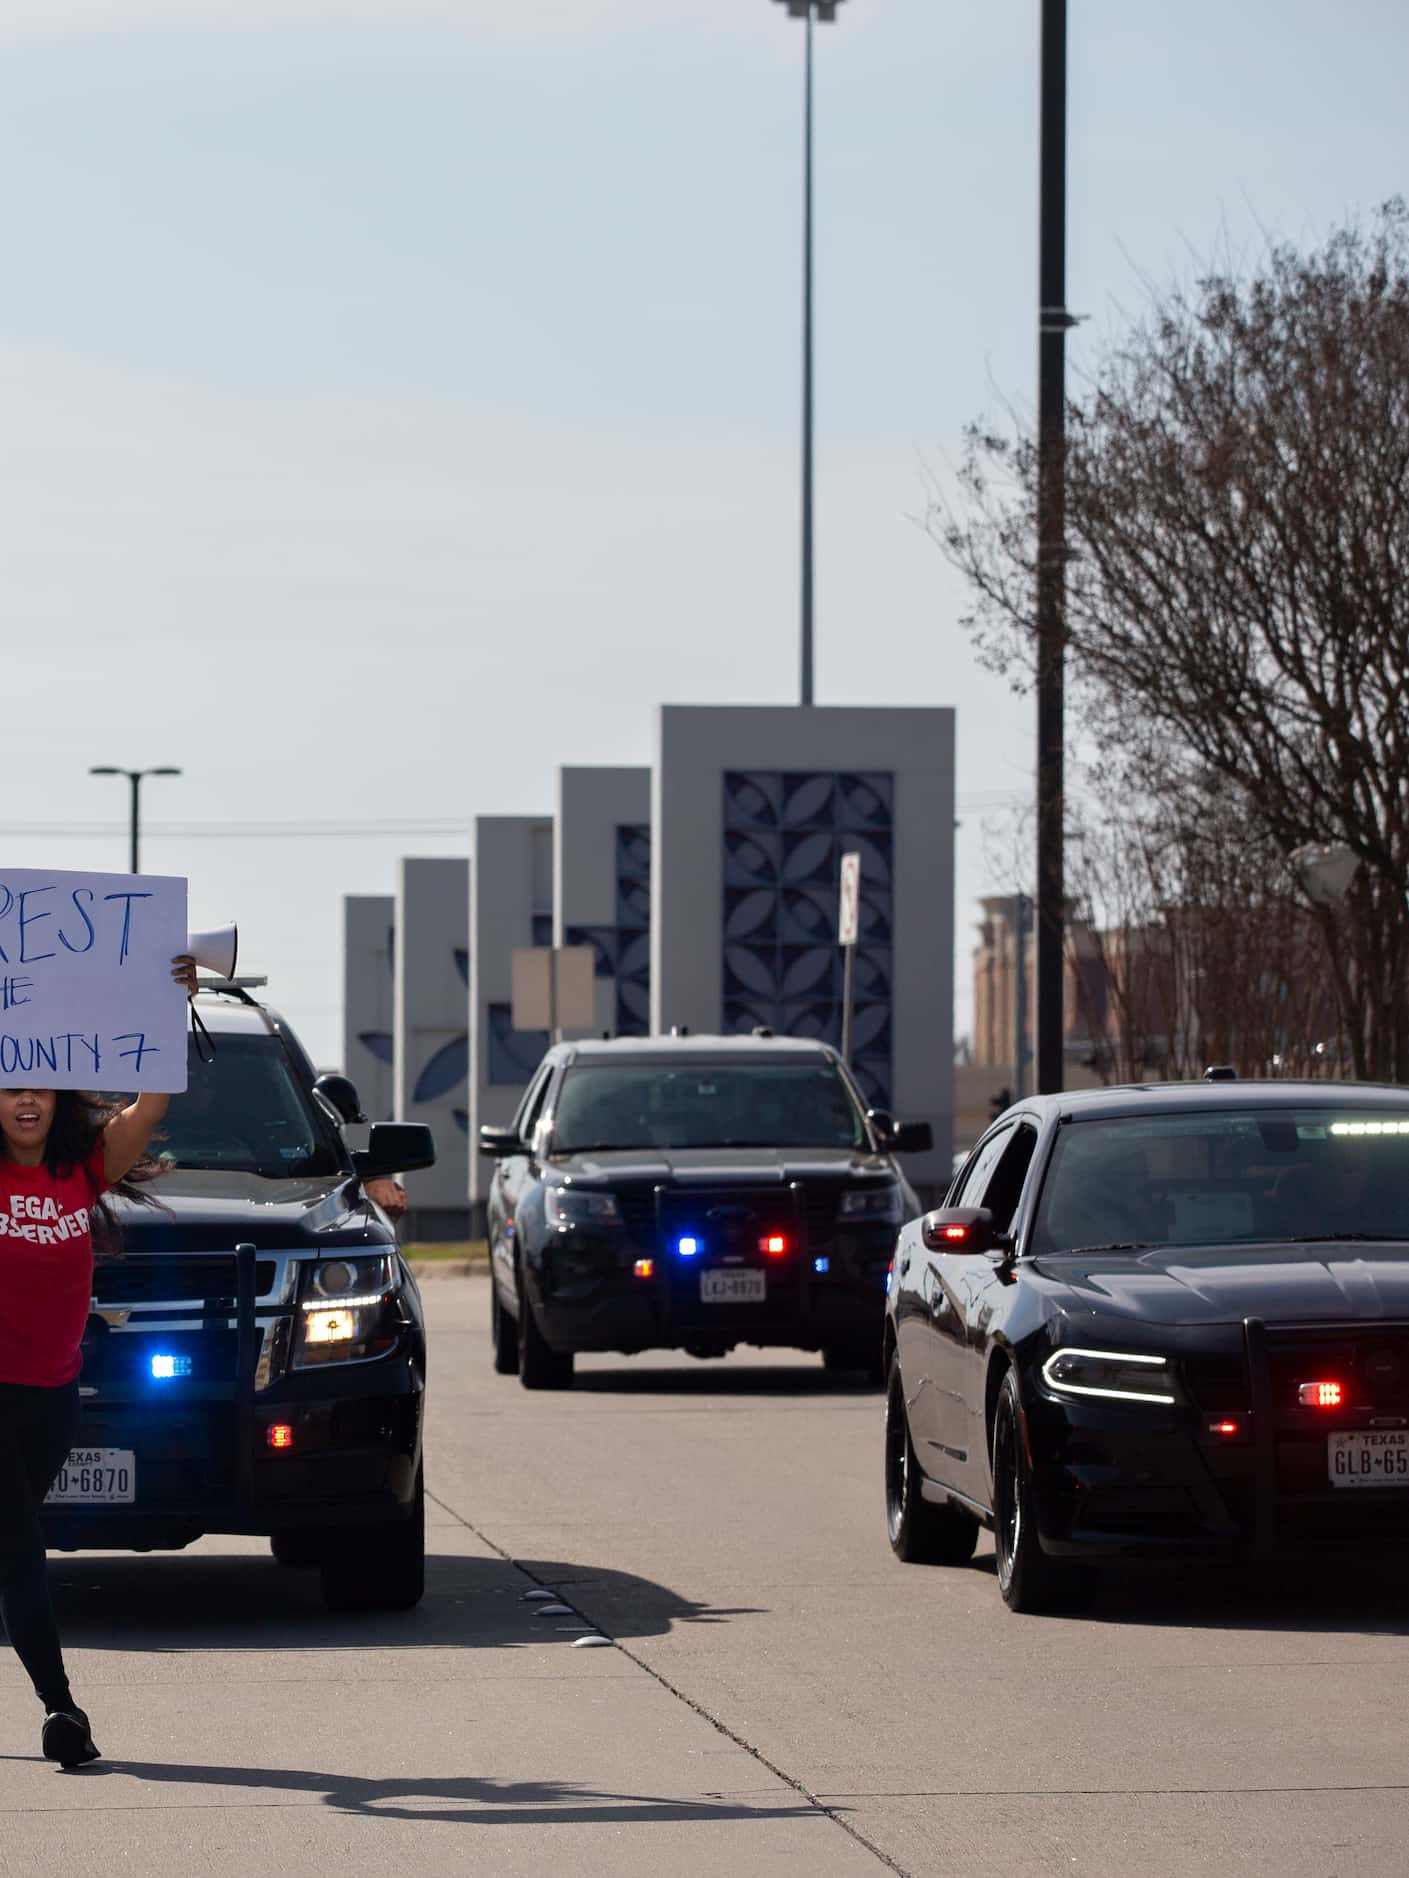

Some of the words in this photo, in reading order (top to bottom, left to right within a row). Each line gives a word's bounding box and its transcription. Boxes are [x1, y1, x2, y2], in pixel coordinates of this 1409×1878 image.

[111, 1033, 160, 1072] 7
[10, 1195, 63, 1221] EGA
[1362, 1434, 1406, 1446] TEXAS
[68, 1452, 101, 1463] EXAS
